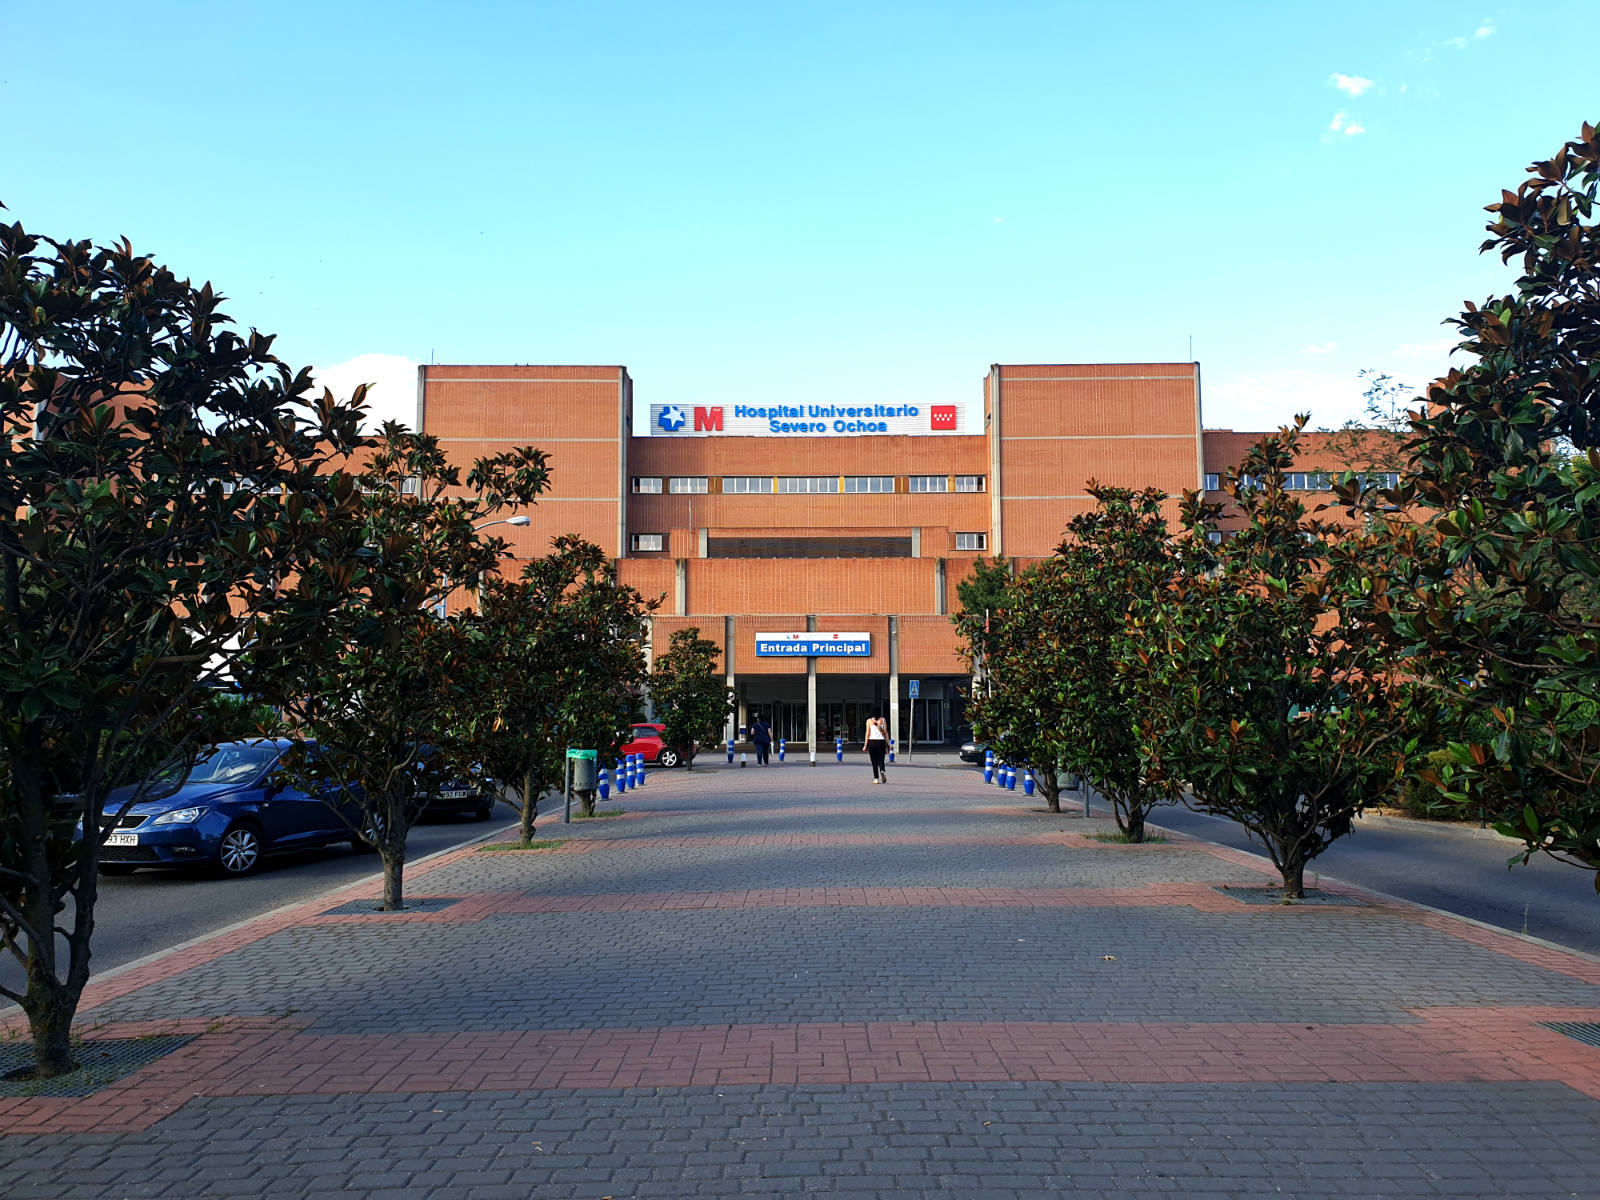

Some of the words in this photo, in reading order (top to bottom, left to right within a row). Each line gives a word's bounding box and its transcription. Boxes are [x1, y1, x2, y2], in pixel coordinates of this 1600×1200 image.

[694, 406, 723, 432] M
[734, 404, 804, 420] Hospital
[808, 404, 920, 418] Universitario
[769, 420, 827, 433] Severo
[833, 419, 888, 433] Ochoa
[760, 643, 808, 653] Entrada
[812, 643, 866, 654] Principal
[120, 835, 136, 844] HXH
